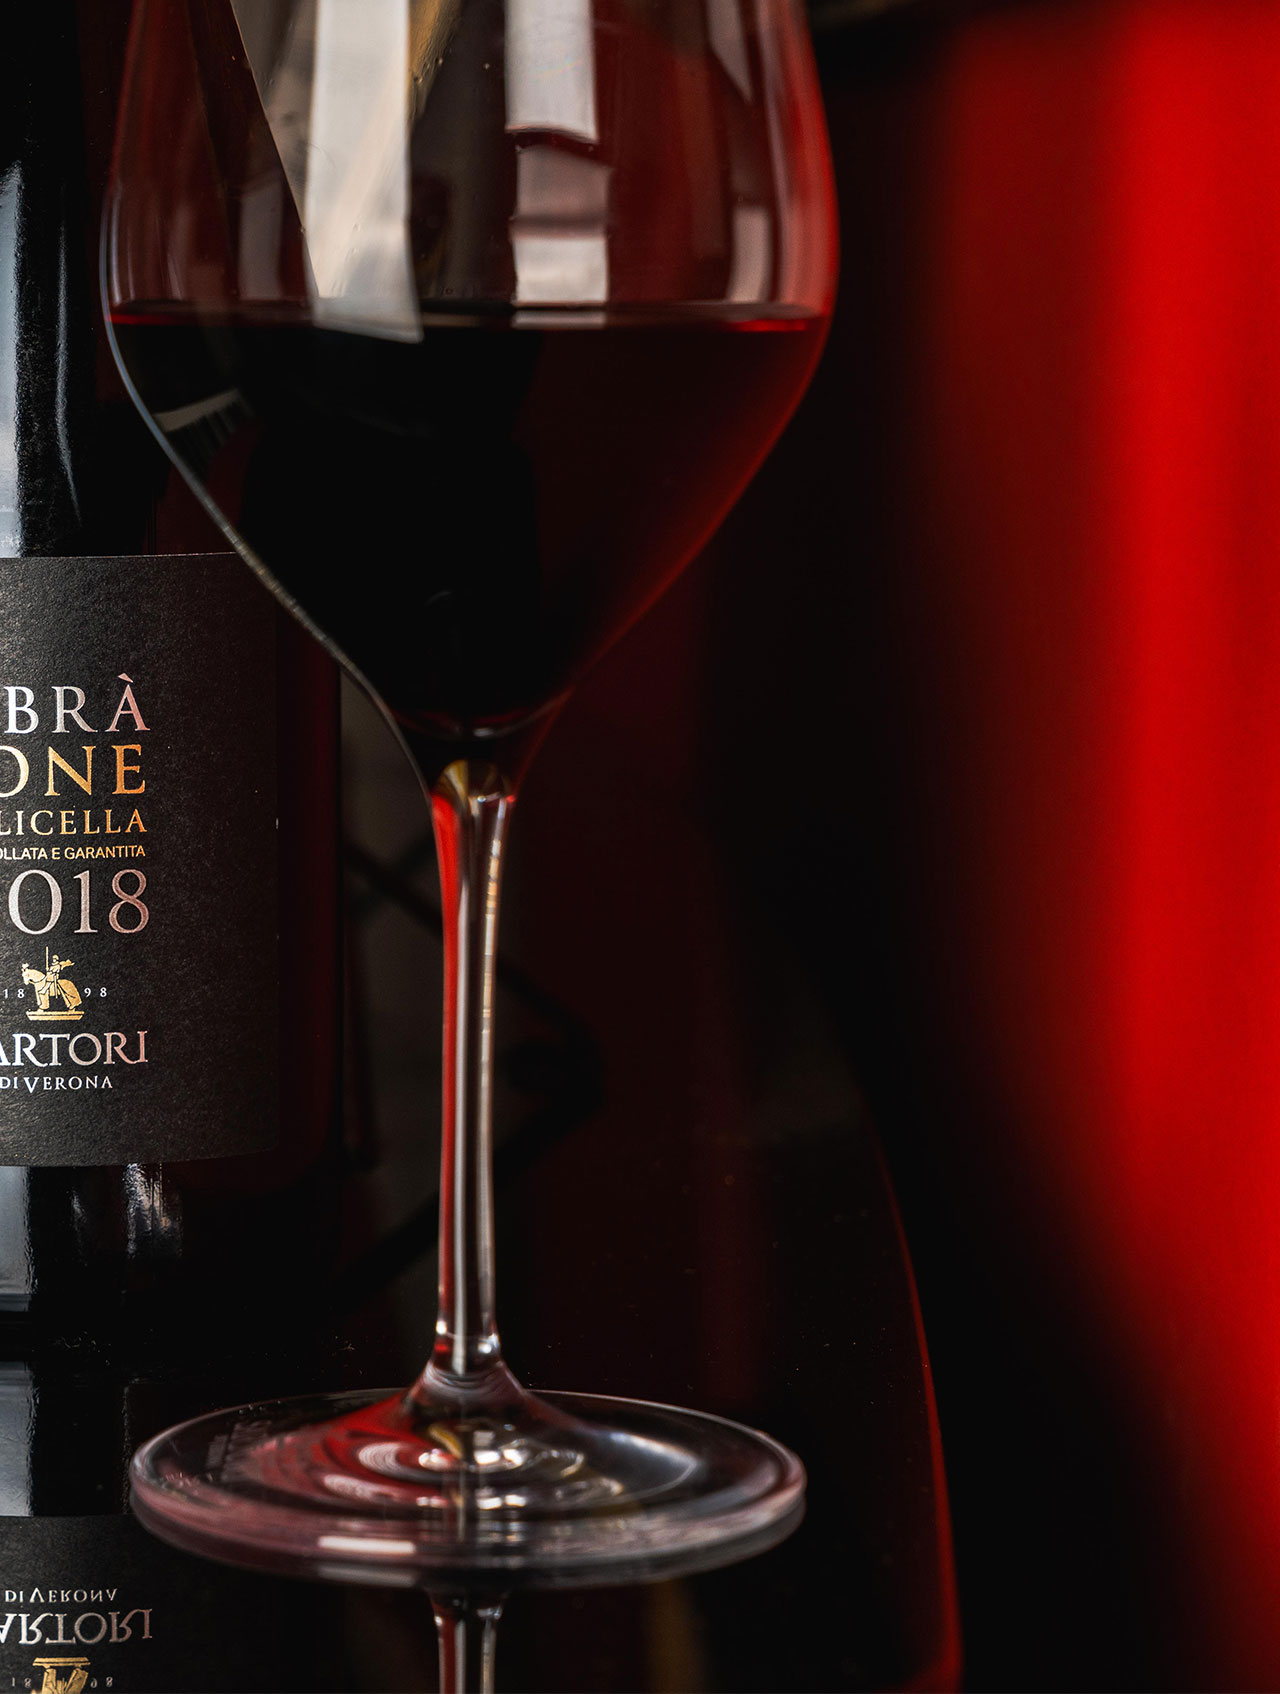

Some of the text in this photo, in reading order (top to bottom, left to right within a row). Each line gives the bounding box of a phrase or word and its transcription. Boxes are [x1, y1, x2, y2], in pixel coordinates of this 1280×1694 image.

[4, 673, 151, 734] BRÀ
[52, 847, 60, 859] E
[64, 845, 145, 860] GARANTITA
[0, 1076, 113, 1093] DI VERONA
